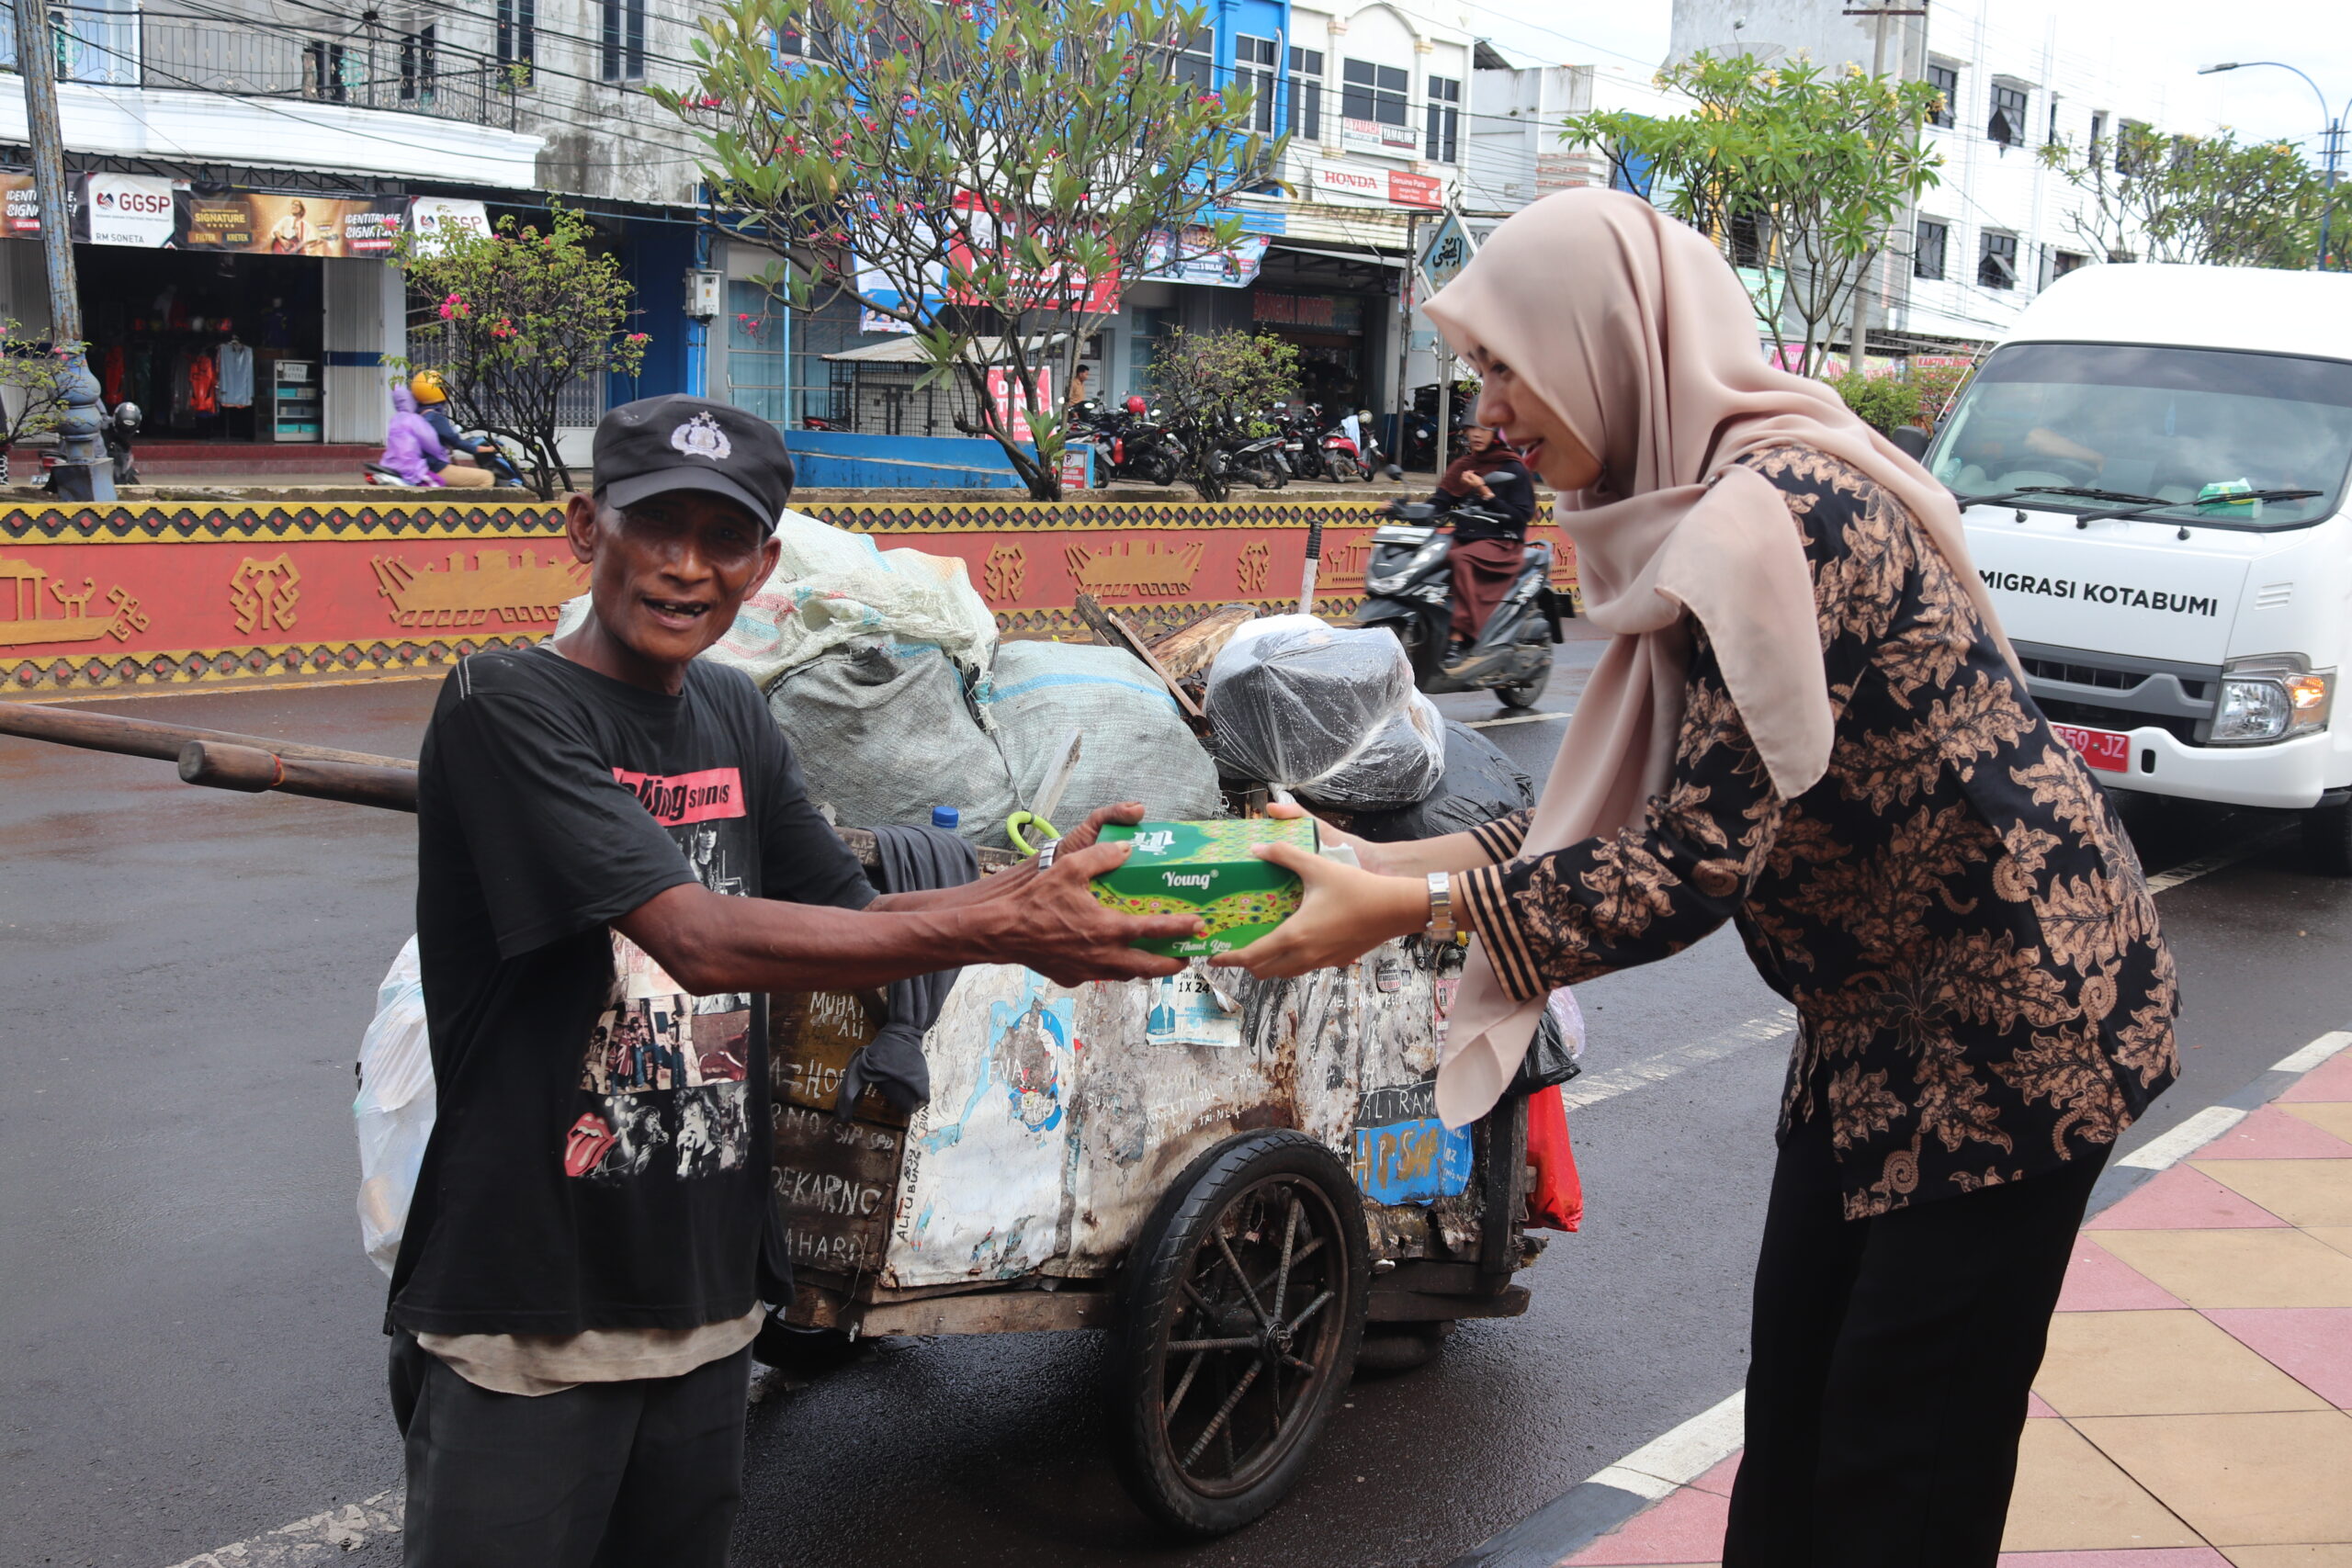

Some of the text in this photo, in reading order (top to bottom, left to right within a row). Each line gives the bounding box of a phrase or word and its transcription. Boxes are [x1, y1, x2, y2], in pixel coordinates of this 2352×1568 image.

[1324, 171, 1377, 189] HONDA
[119, 193, 171, 213] GGSP
[195, 212, 246, 224] SIGNATURE
[96, 232, 144, 243] RM SONETA
[1979, 570, 2219, 617] MIGRASI KOTABUMI
[2100, 735, 2126, 759] JZ
[1162, 870, 1211, 890] Young
[1172, 939, 1232, 954] Thank You
[1179, 982, 1183, 993] 1
[1195, 982, 1210, 993] 24
